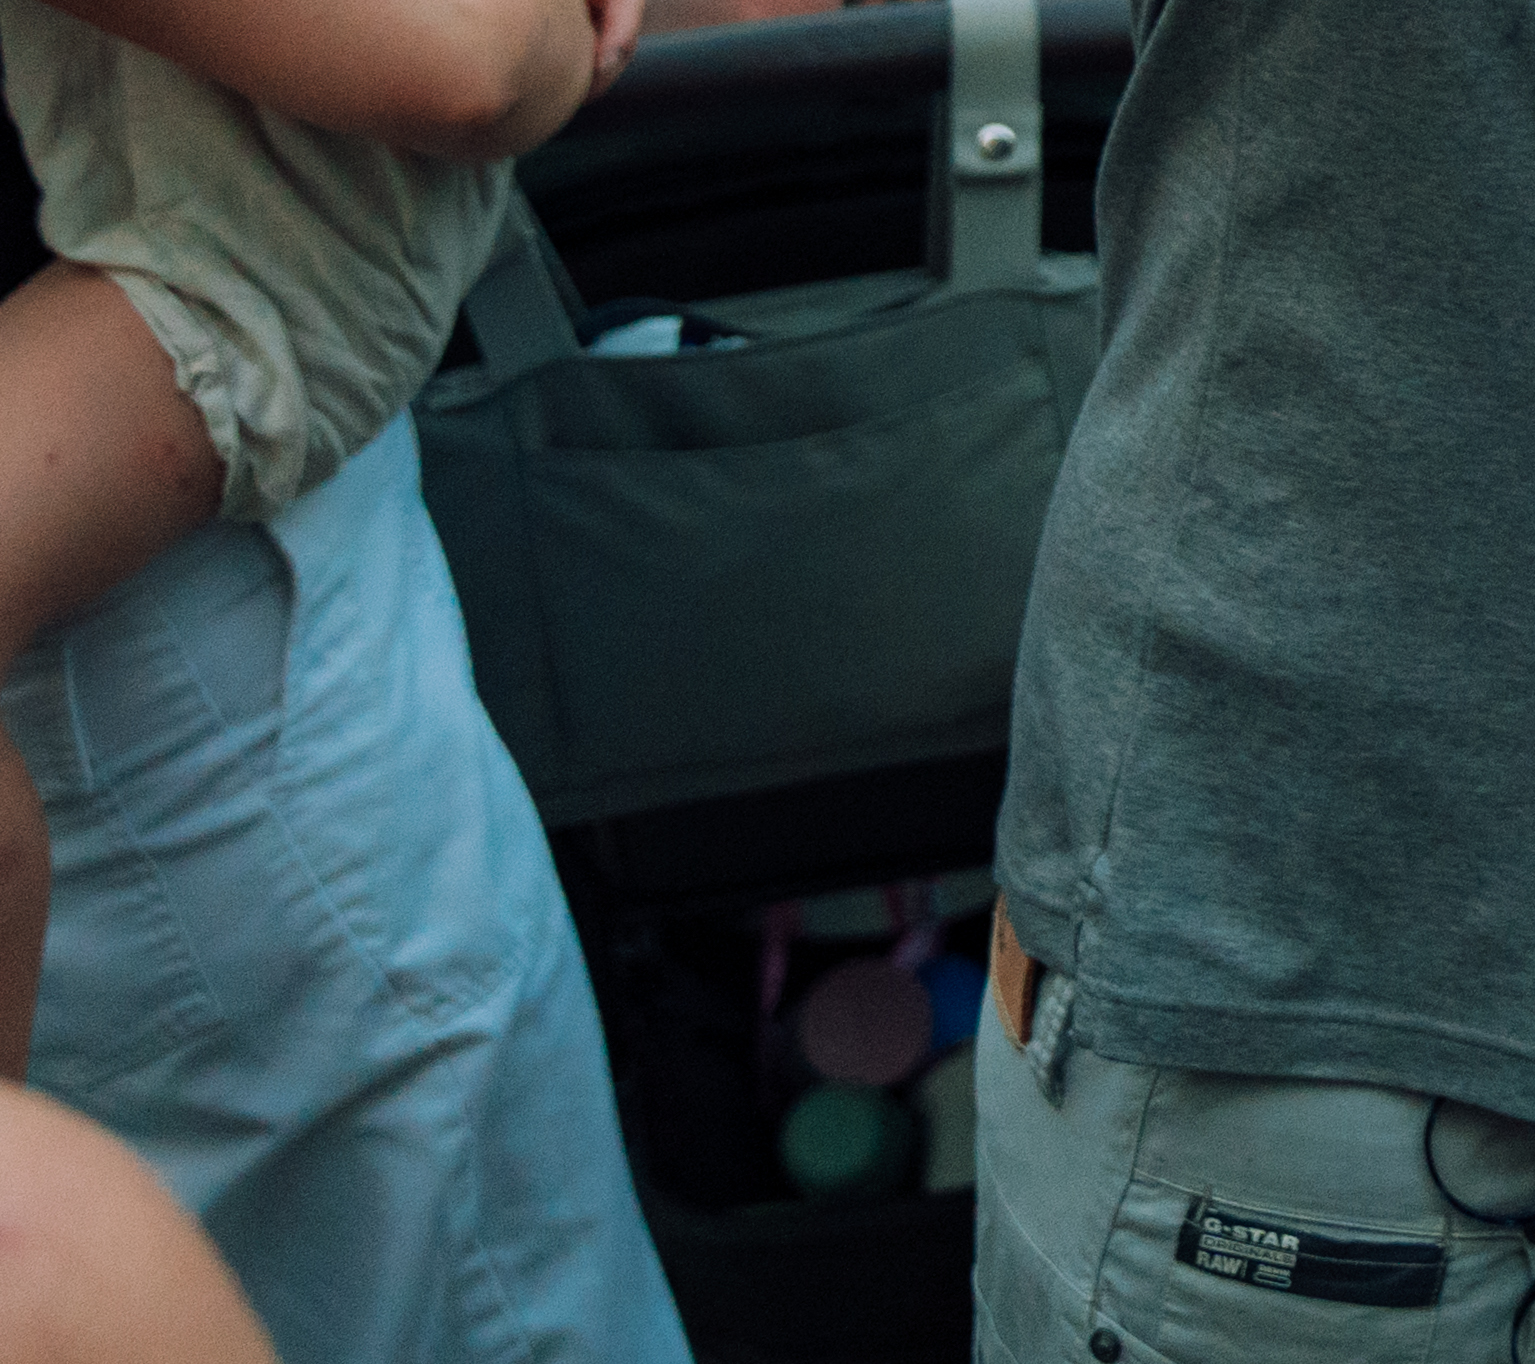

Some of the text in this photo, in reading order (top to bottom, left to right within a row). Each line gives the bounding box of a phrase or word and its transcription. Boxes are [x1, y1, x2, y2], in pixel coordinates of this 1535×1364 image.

[1204, 1217, 1299, 1251] G-STAR
[1197, 1251, 1241, 1275] RAW
[1204, 1237, 1293, 1263] ORIGINALS
